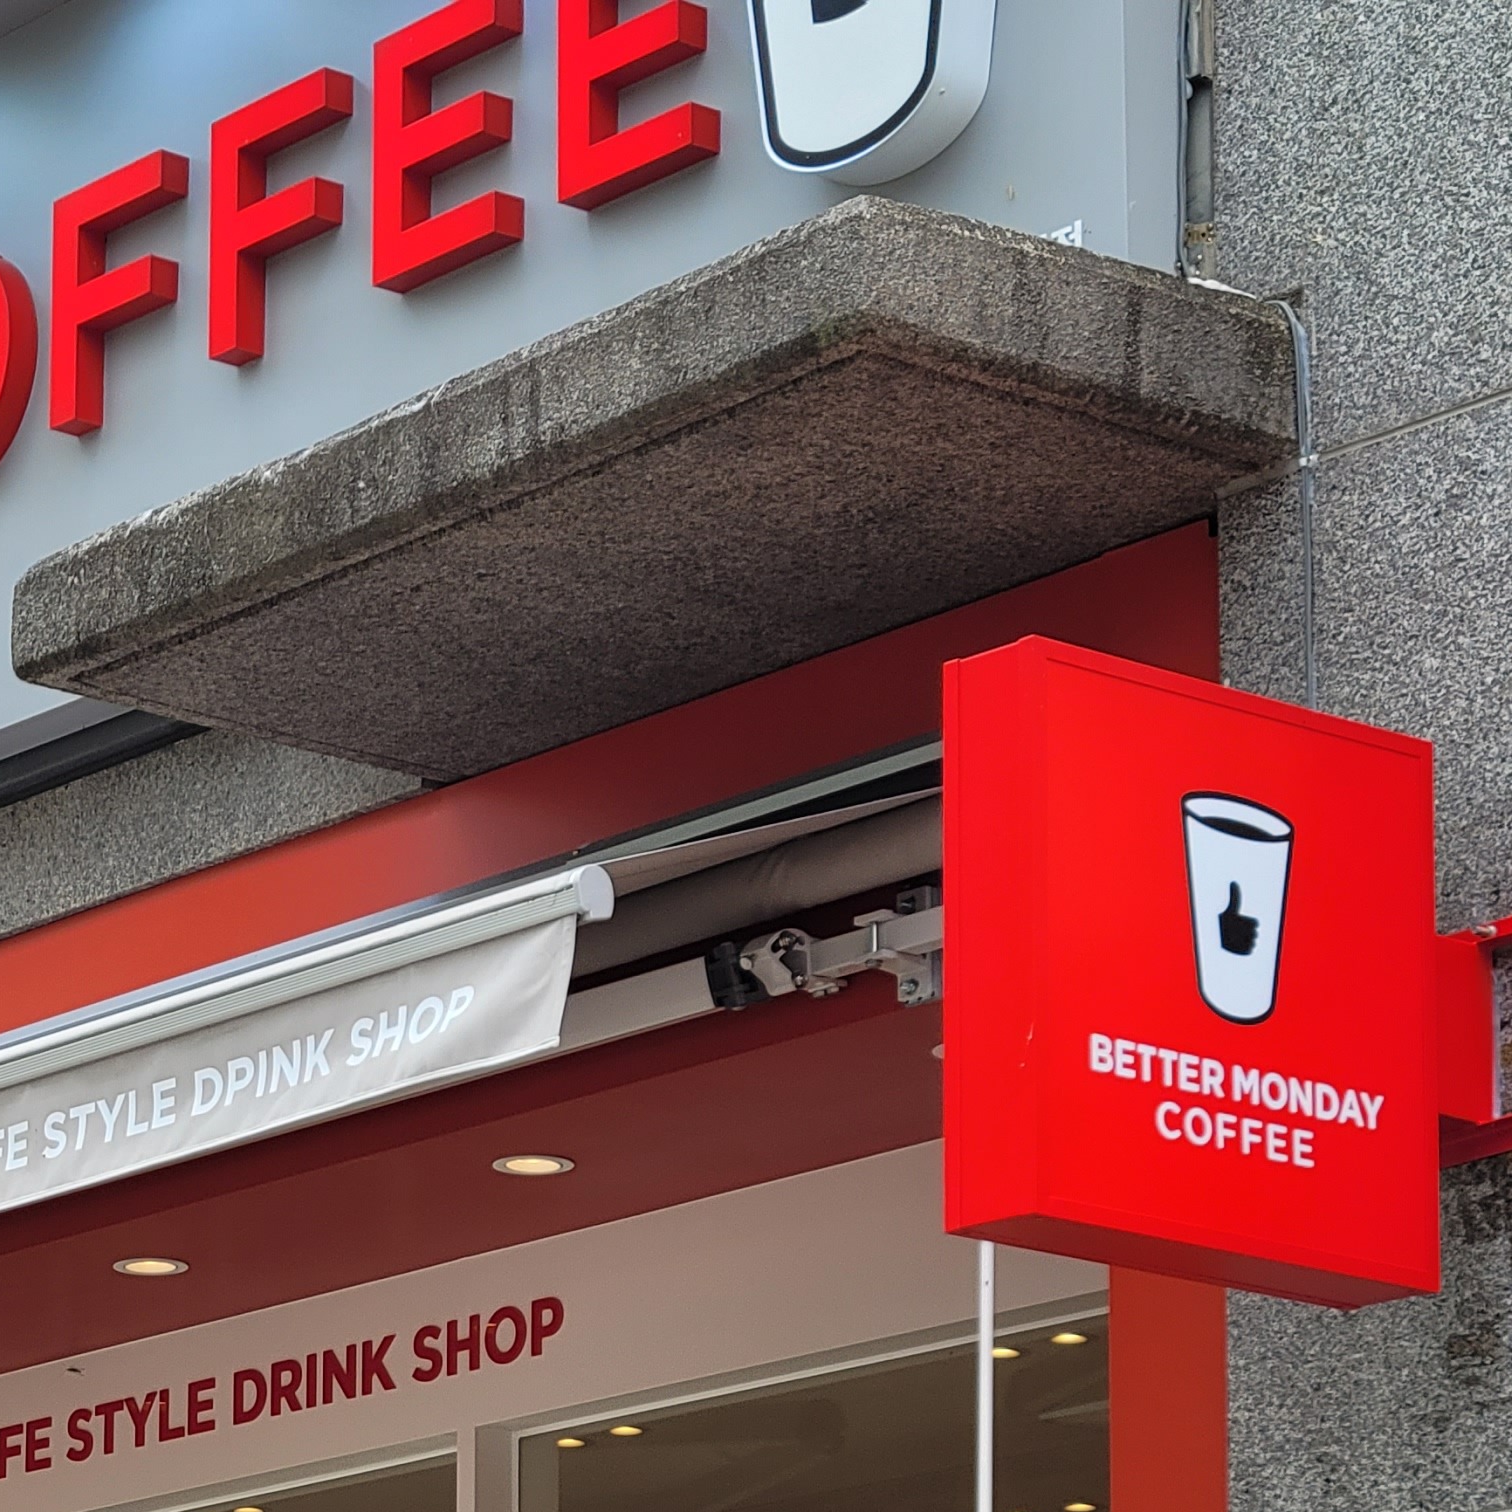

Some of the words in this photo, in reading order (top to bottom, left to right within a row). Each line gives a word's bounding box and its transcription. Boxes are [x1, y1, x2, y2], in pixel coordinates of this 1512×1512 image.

[42, 1077, 177, 1158] STYLE
[190, 1027, 335, 1117] DPINK
[346, 986, 475, 1066] SHOP
[1090, 1033, 1225, 1098] BETTER
[1232, 1065, 1384, 1131] MONDAY
[1155, 1101, 1315, 1168] COFFEE
[66, 1376, 216, 1462] STYLE
[232, 1334, 397, 1426] DRINK
[412, 1296, 564, 1383] SHOP
